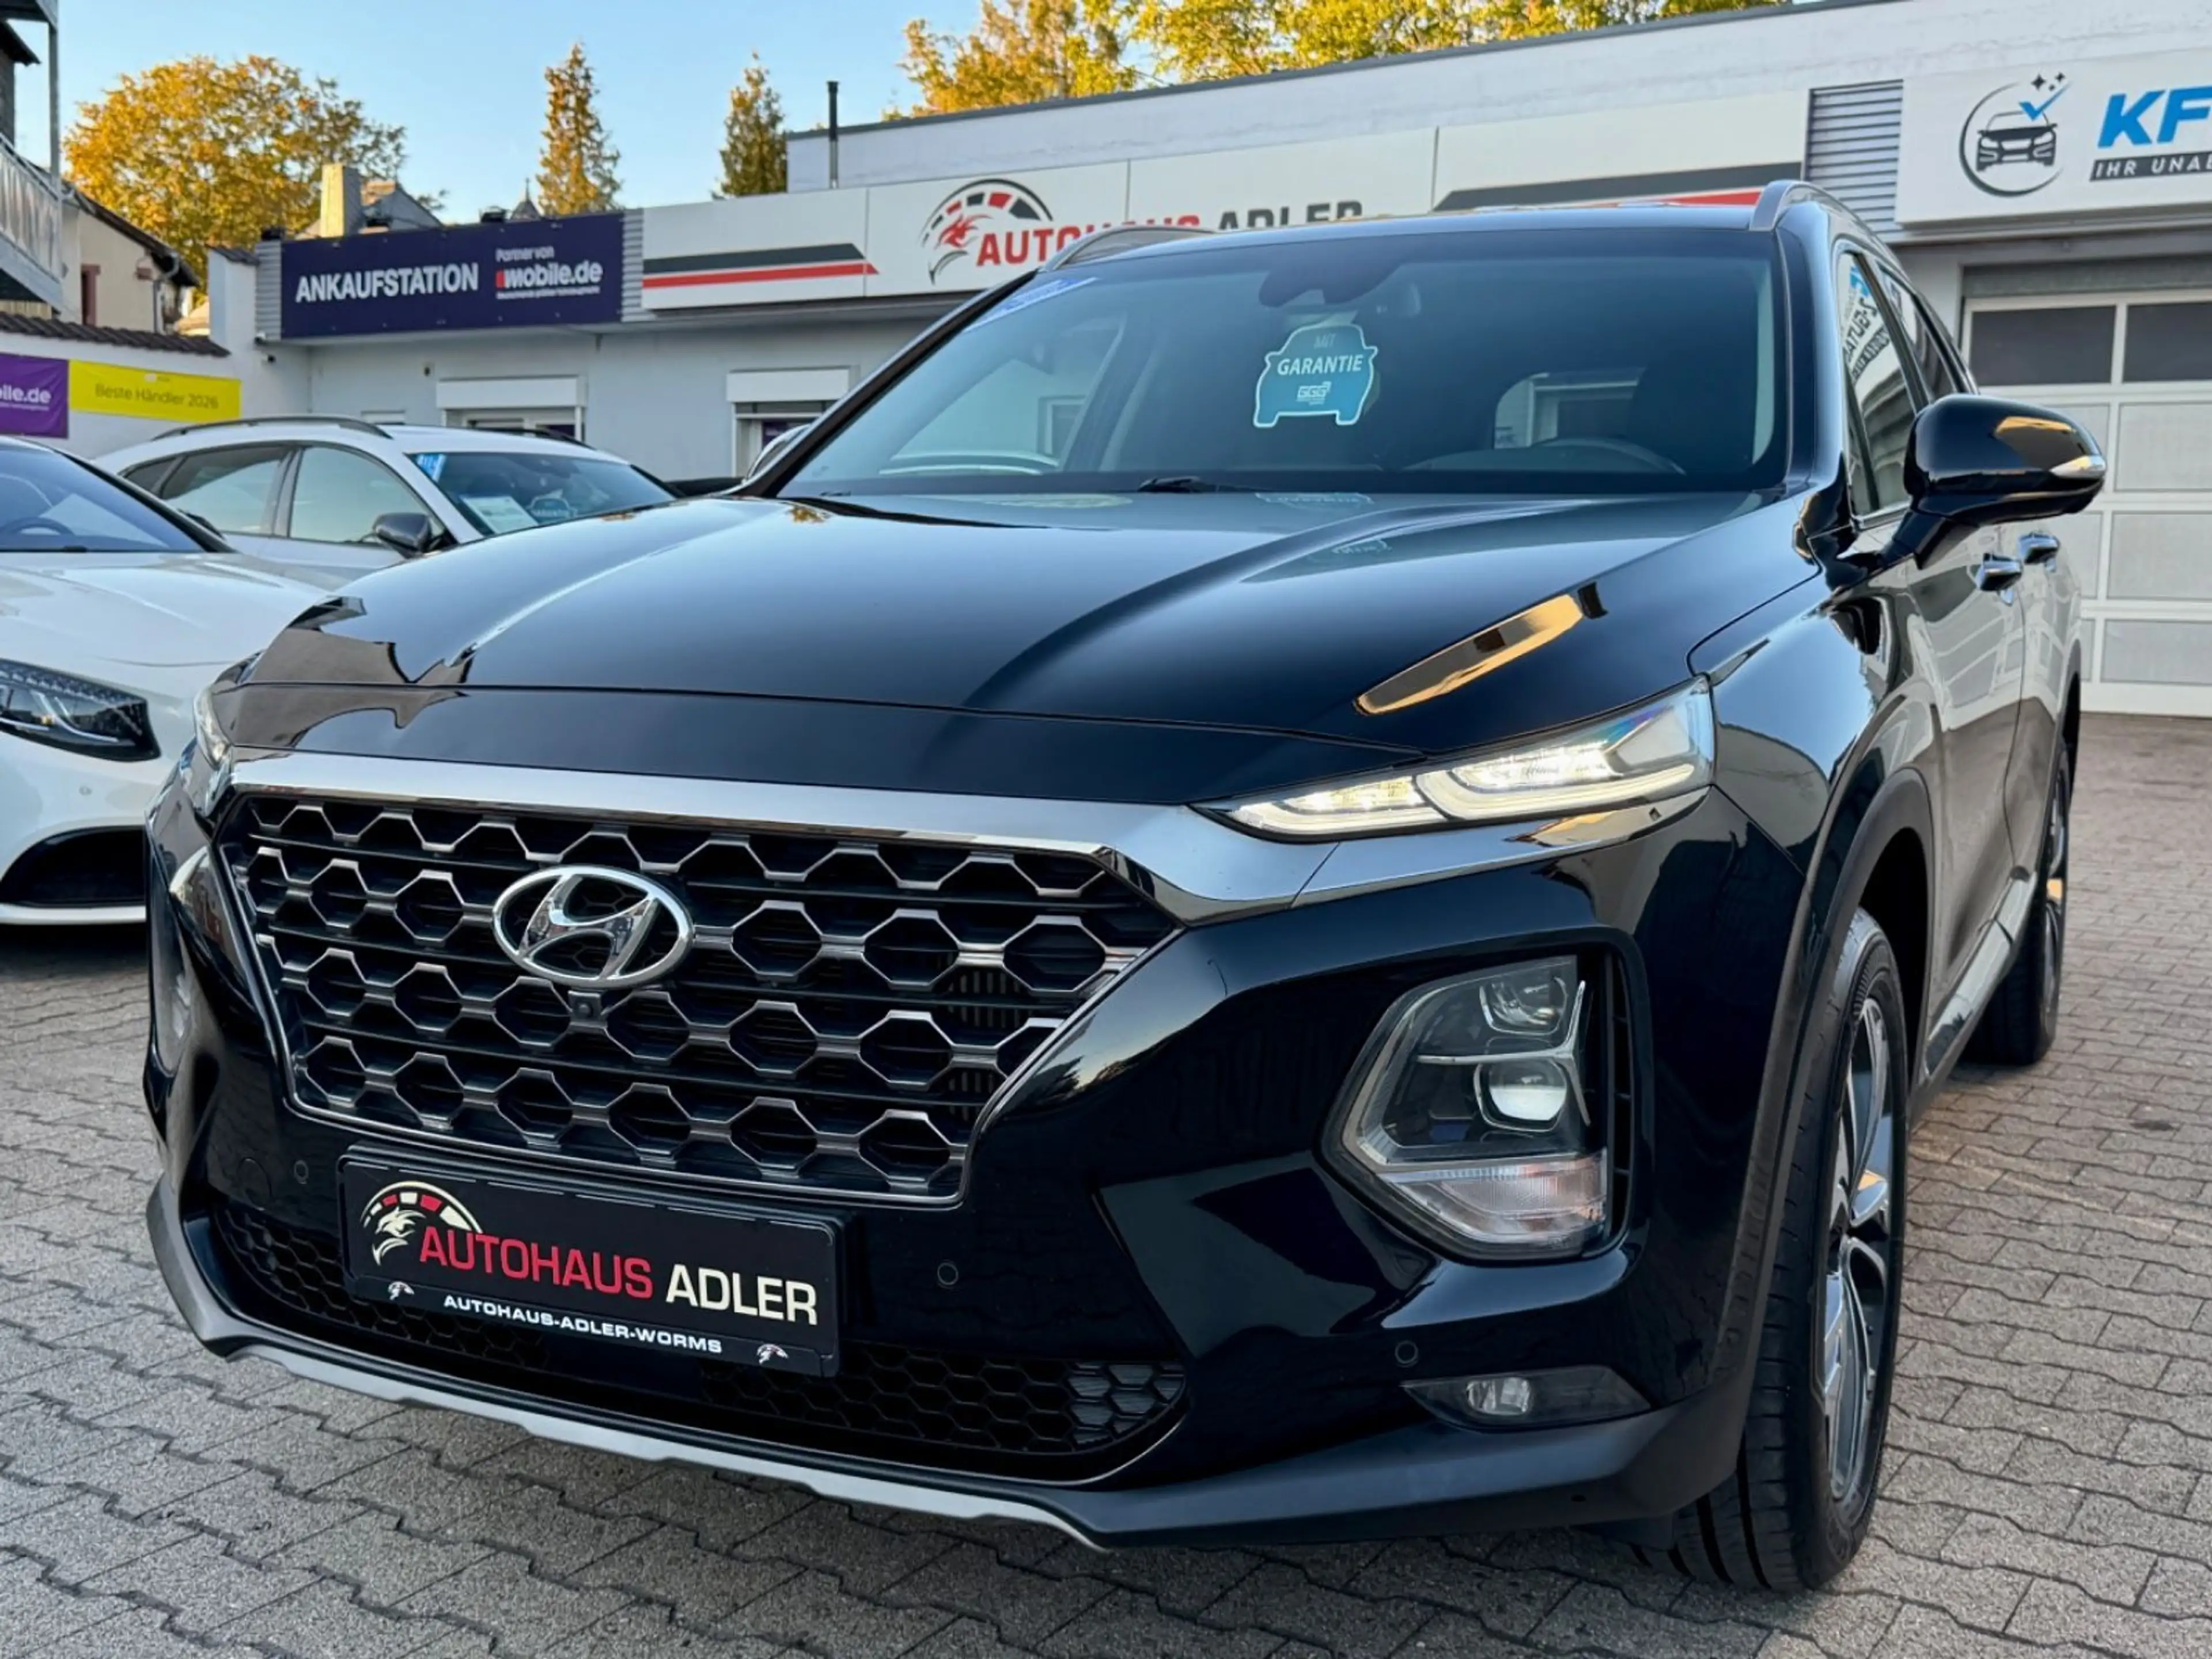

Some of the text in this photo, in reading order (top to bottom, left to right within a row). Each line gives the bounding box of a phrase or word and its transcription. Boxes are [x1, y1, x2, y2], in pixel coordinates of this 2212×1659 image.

[2096, 160, 2137, 177] IHR
[296, 262, 479, 303] ANKAUFSTATION
[504, 260, 603, 287] mobile.de
[1277, 354, 1363, 376] GARANTIE
[0, 384, 52, 404] ile.de
[95, 382, 132, 399] Beste
[420, 1226, 818, 1325] AUTOHAUS ADLER
[444, 1294, 723, 1354] AUTOHAUS-ADLER-WORMS
